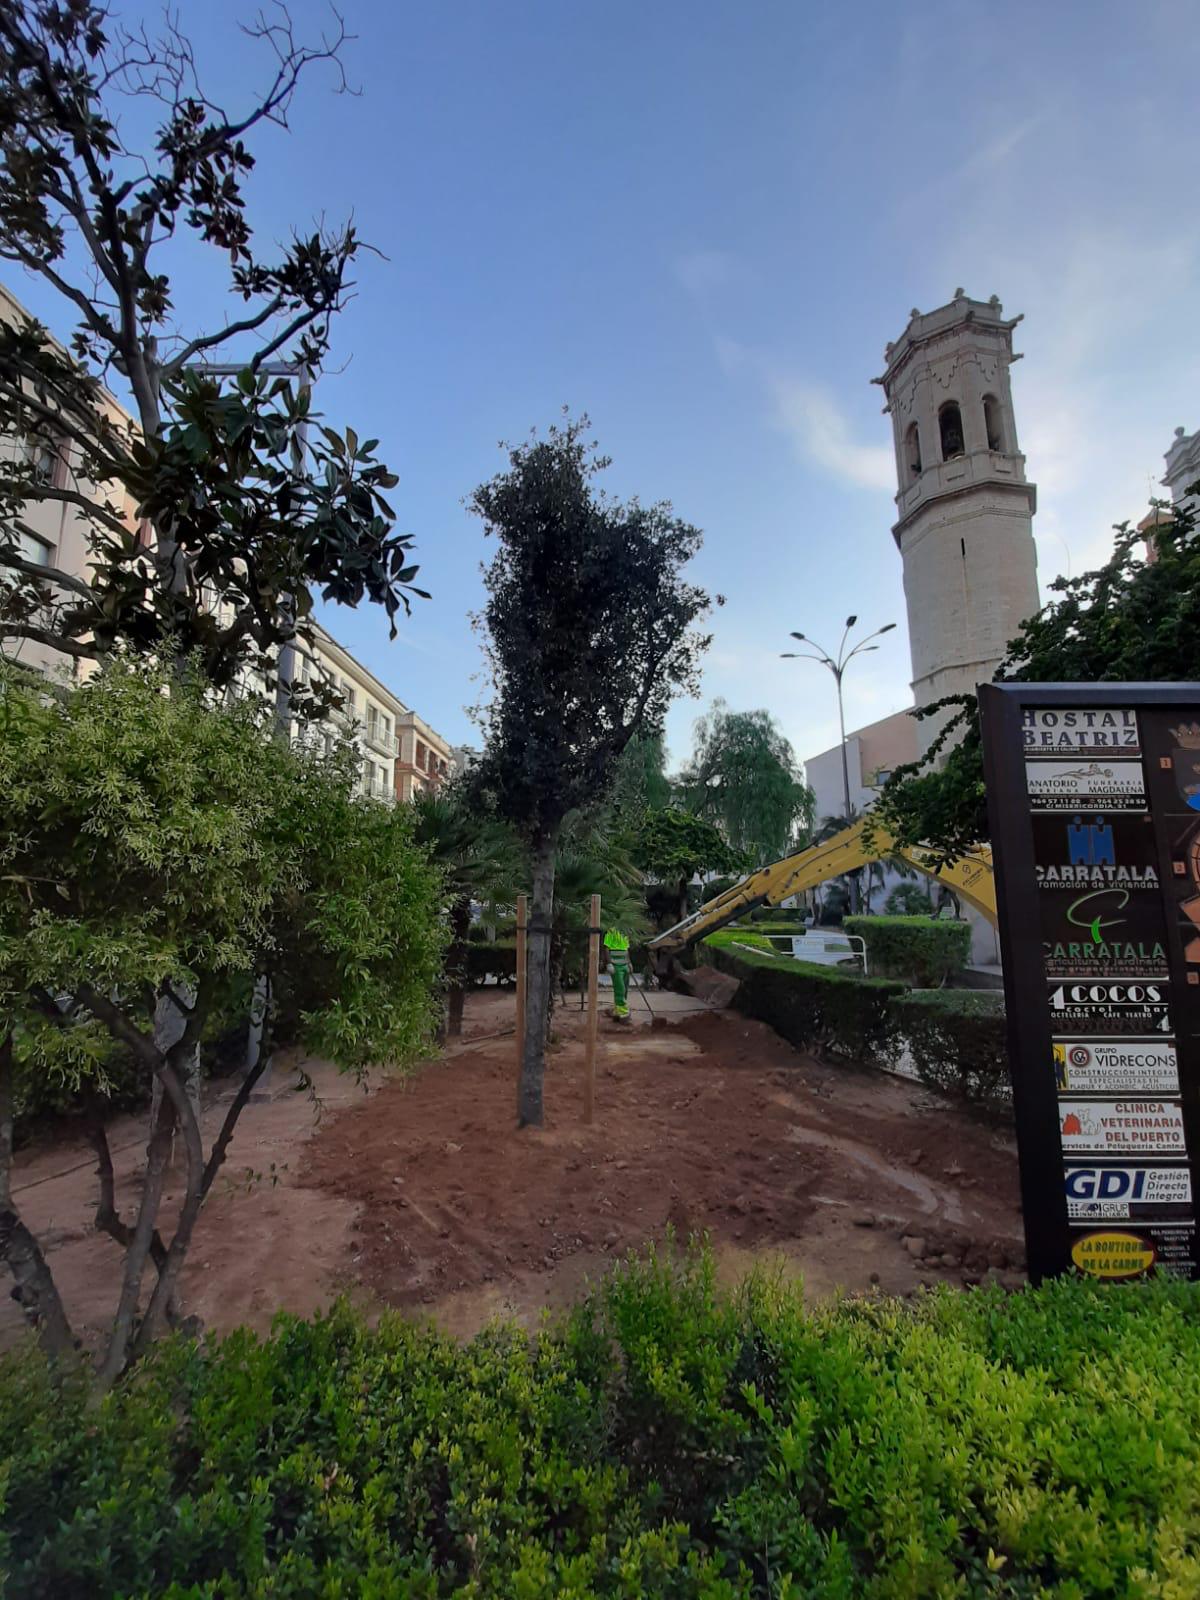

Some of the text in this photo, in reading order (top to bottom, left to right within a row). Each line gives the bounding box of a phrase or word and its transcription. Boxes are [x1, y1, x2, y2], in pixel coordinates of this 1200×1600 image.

[1023, 710, 1136, 728] HOSTAL
[1023, 729, 1138, 746] BEATRIZ
[1088, 786, 1143, 794] MAGDALENA
[1035, 865, 1158, 881] CARRATALA
[1038, 880, 1160, 889] romoción de viviendas
[1070, 985, 1162, 1003] COCOS
[1143, 1005, 1168, 1013] bar
[1095, 1055, 1176, 1067] VIDRECONS
[1100, 1118, 1182, 1128] VETERINARIA
[1105, 1132, 1180, 1142] DEL PUERTO
[1149, 1171, 1189, 1181] Gestión
[1065, 1170, 1146, 1199] GDI
[1147, 1181, 1188, 1191] Directa
[1145, 1191, 1187, 1201] Integral
[1081, 1241, 1093, 1252] LA
